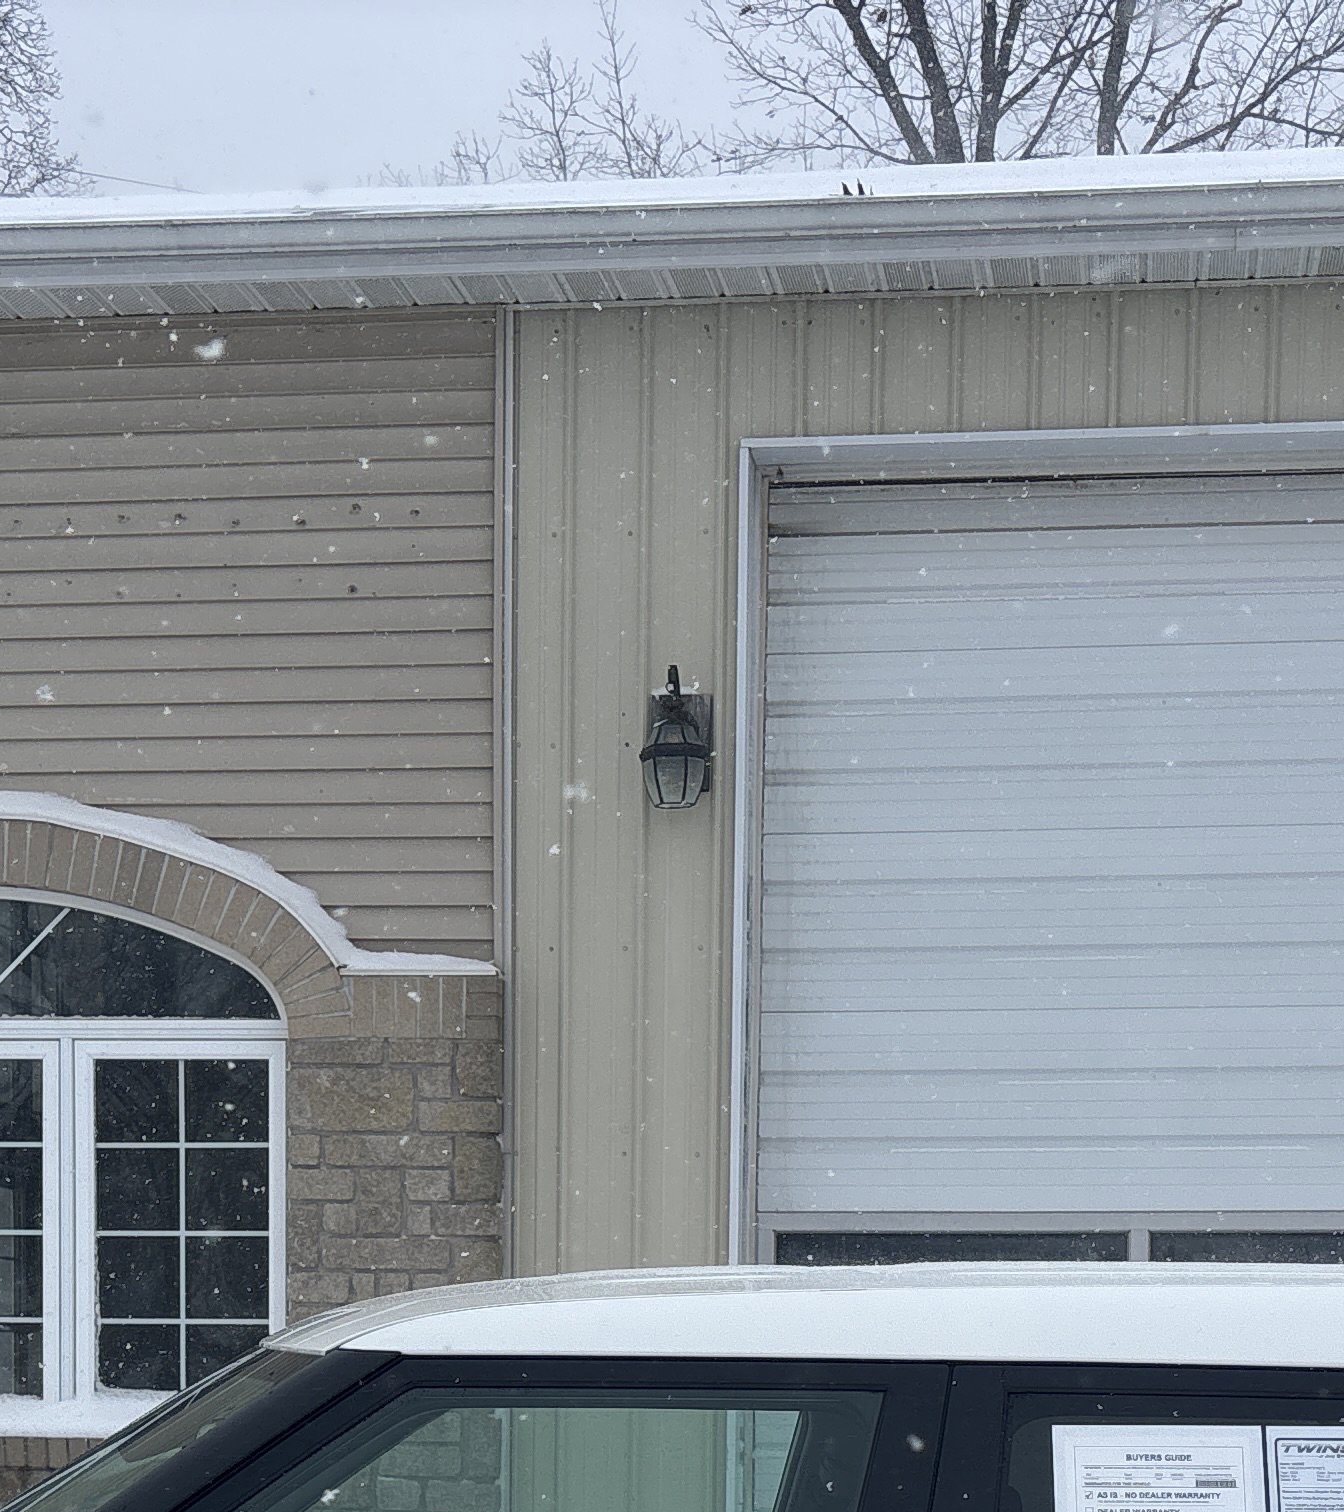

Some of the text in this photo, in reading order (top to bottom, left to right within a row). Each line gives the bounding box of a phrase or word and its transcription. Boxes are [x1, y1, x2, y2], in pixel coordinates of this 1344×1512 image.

[1125, 1454, 1192, 1462] BUYERS GUIDE
[1097, 1491, 1108, 1499] AS
[1124, 1491, 1138, 1499] NO
[1139, 1491, 1173, 1499] DEALER
[1174, 1492, 1221, 1500] WARRANTY
